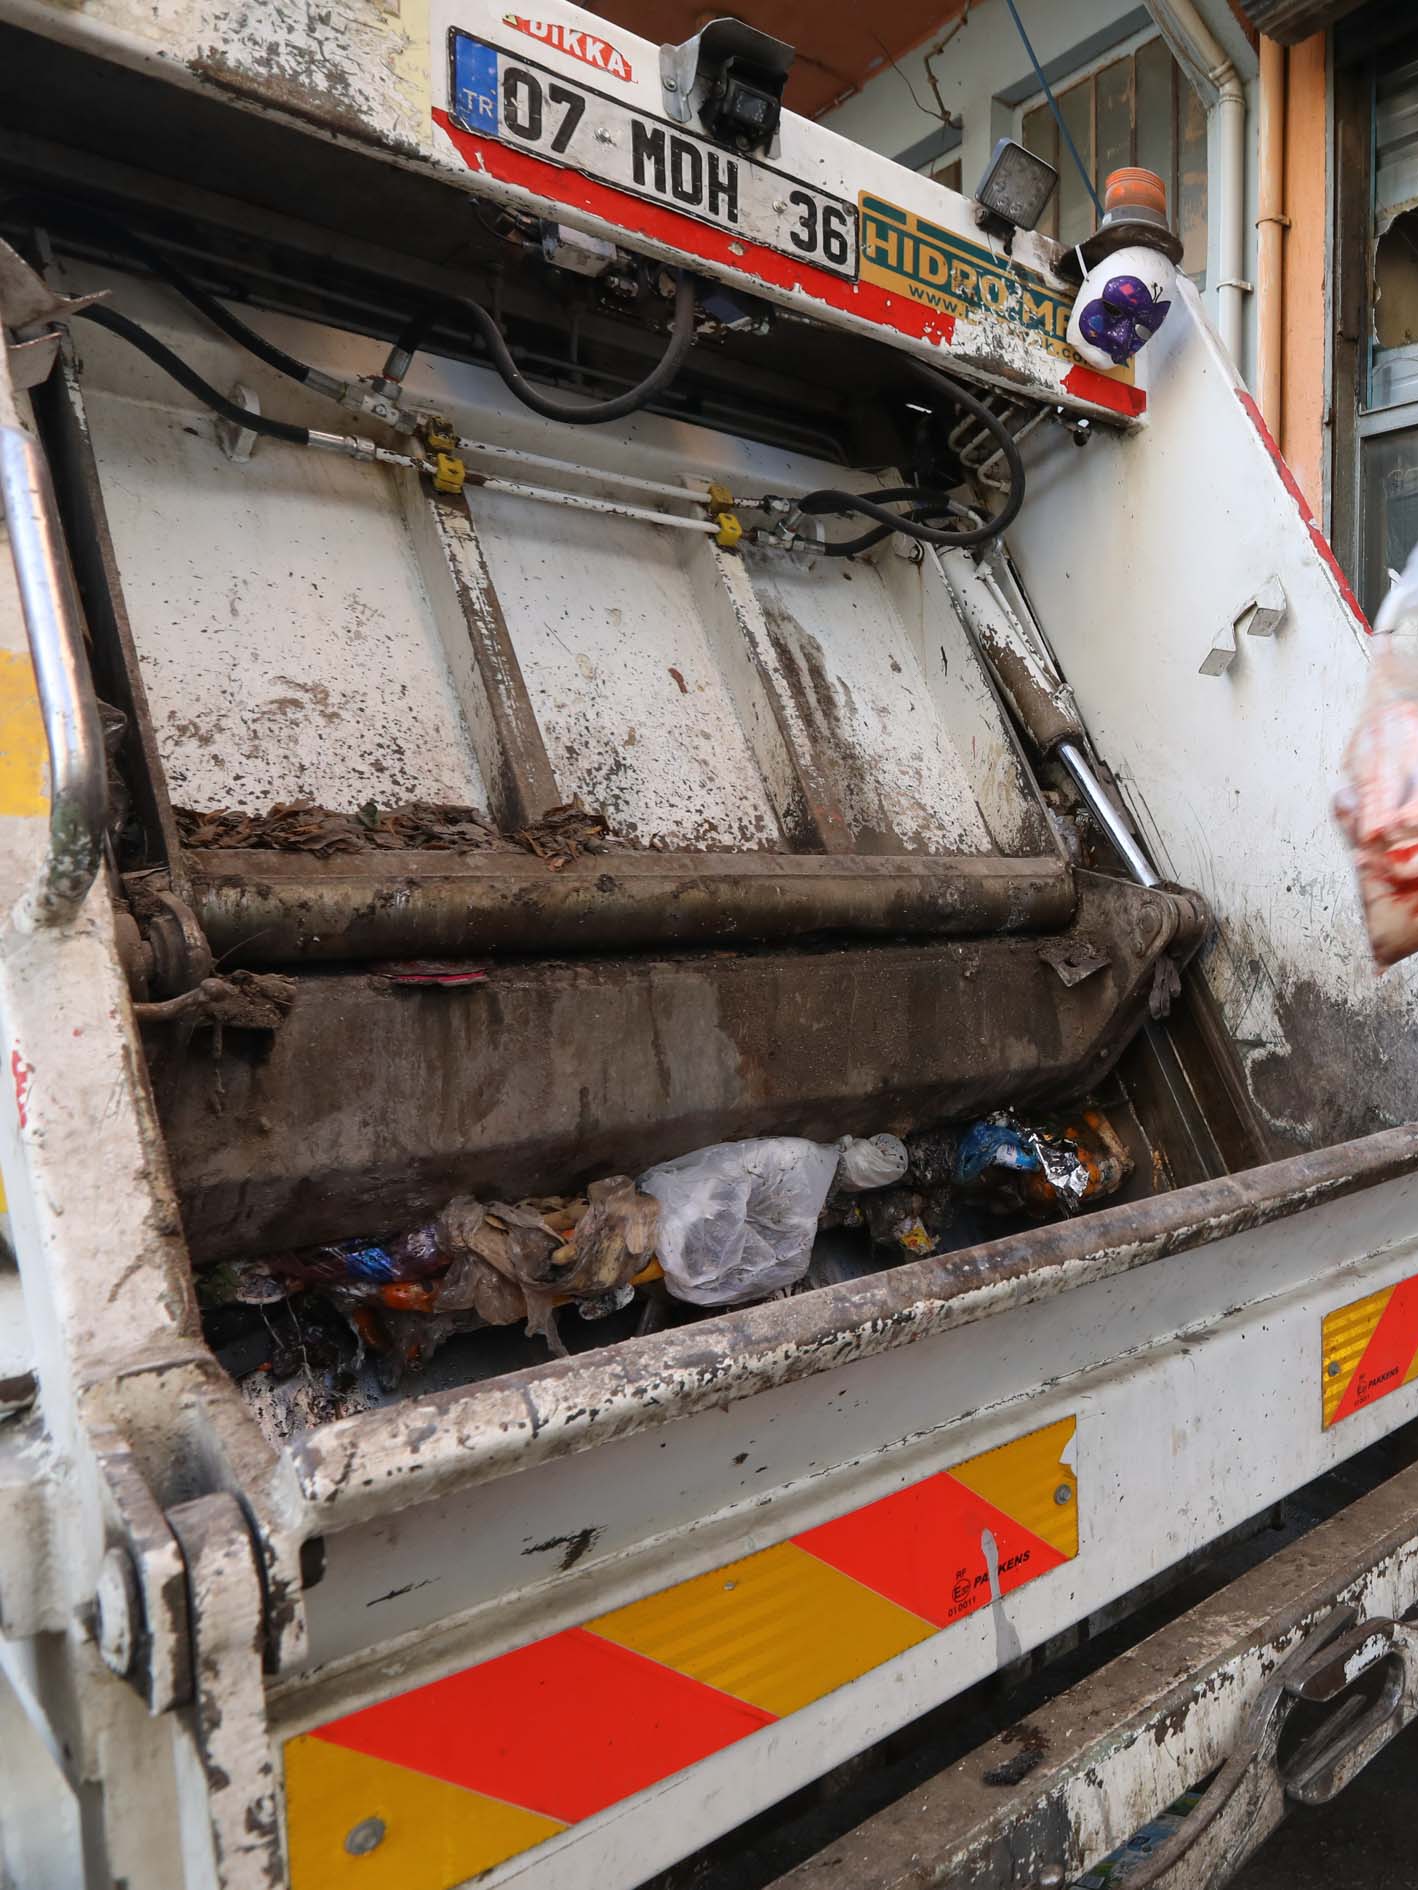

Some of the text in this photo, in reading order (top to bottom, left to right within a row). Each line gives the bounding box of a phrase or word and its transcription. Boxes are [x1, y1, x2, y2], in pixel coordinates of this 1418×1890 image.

[462, 88, 494, 119] TR
[503, 67, 848, 265] 07 MDH 36
[973, 1549, 1031, 1589] PAKENS
